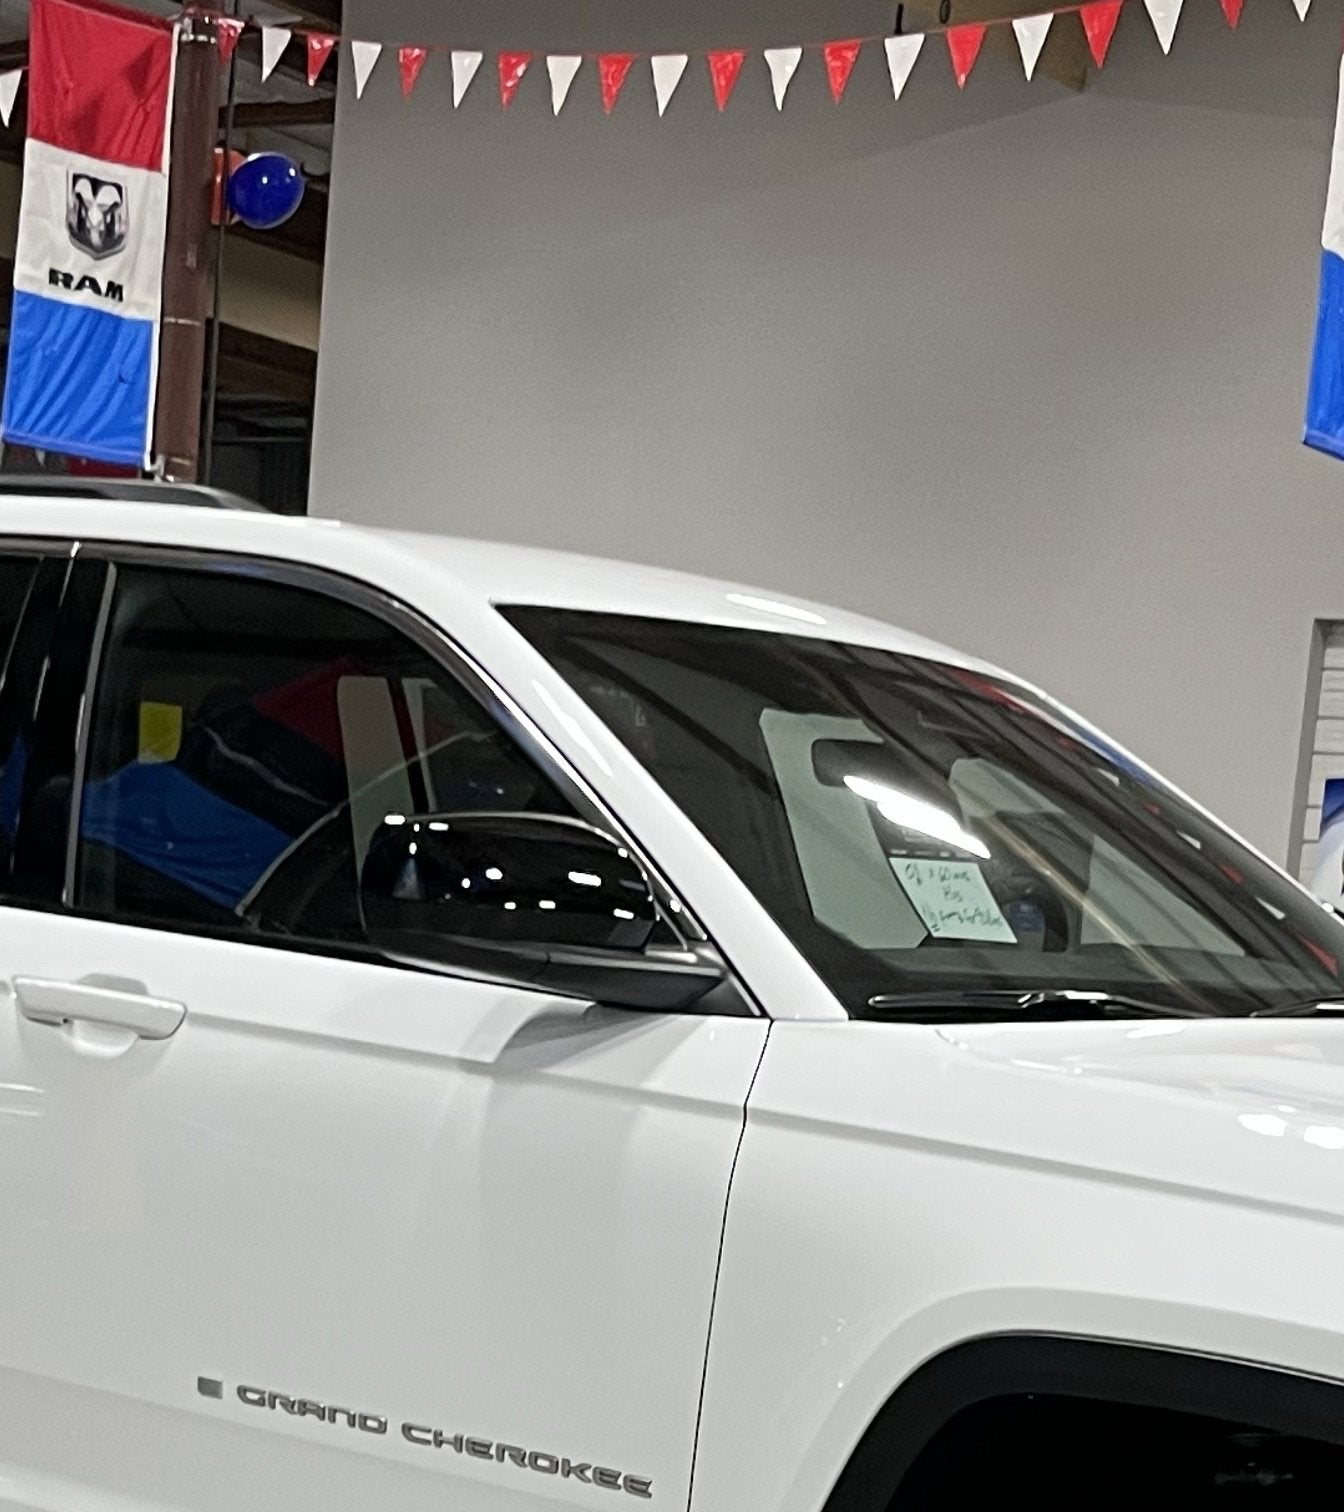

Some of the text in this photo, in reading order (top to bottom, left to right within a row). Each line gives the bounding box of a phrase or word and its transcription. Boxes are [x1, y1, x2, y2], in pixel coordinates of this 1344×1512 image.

[48, 267, 124, 303] RAM
[236, 1384, 653, 1499] GRAND CHEROKEE
